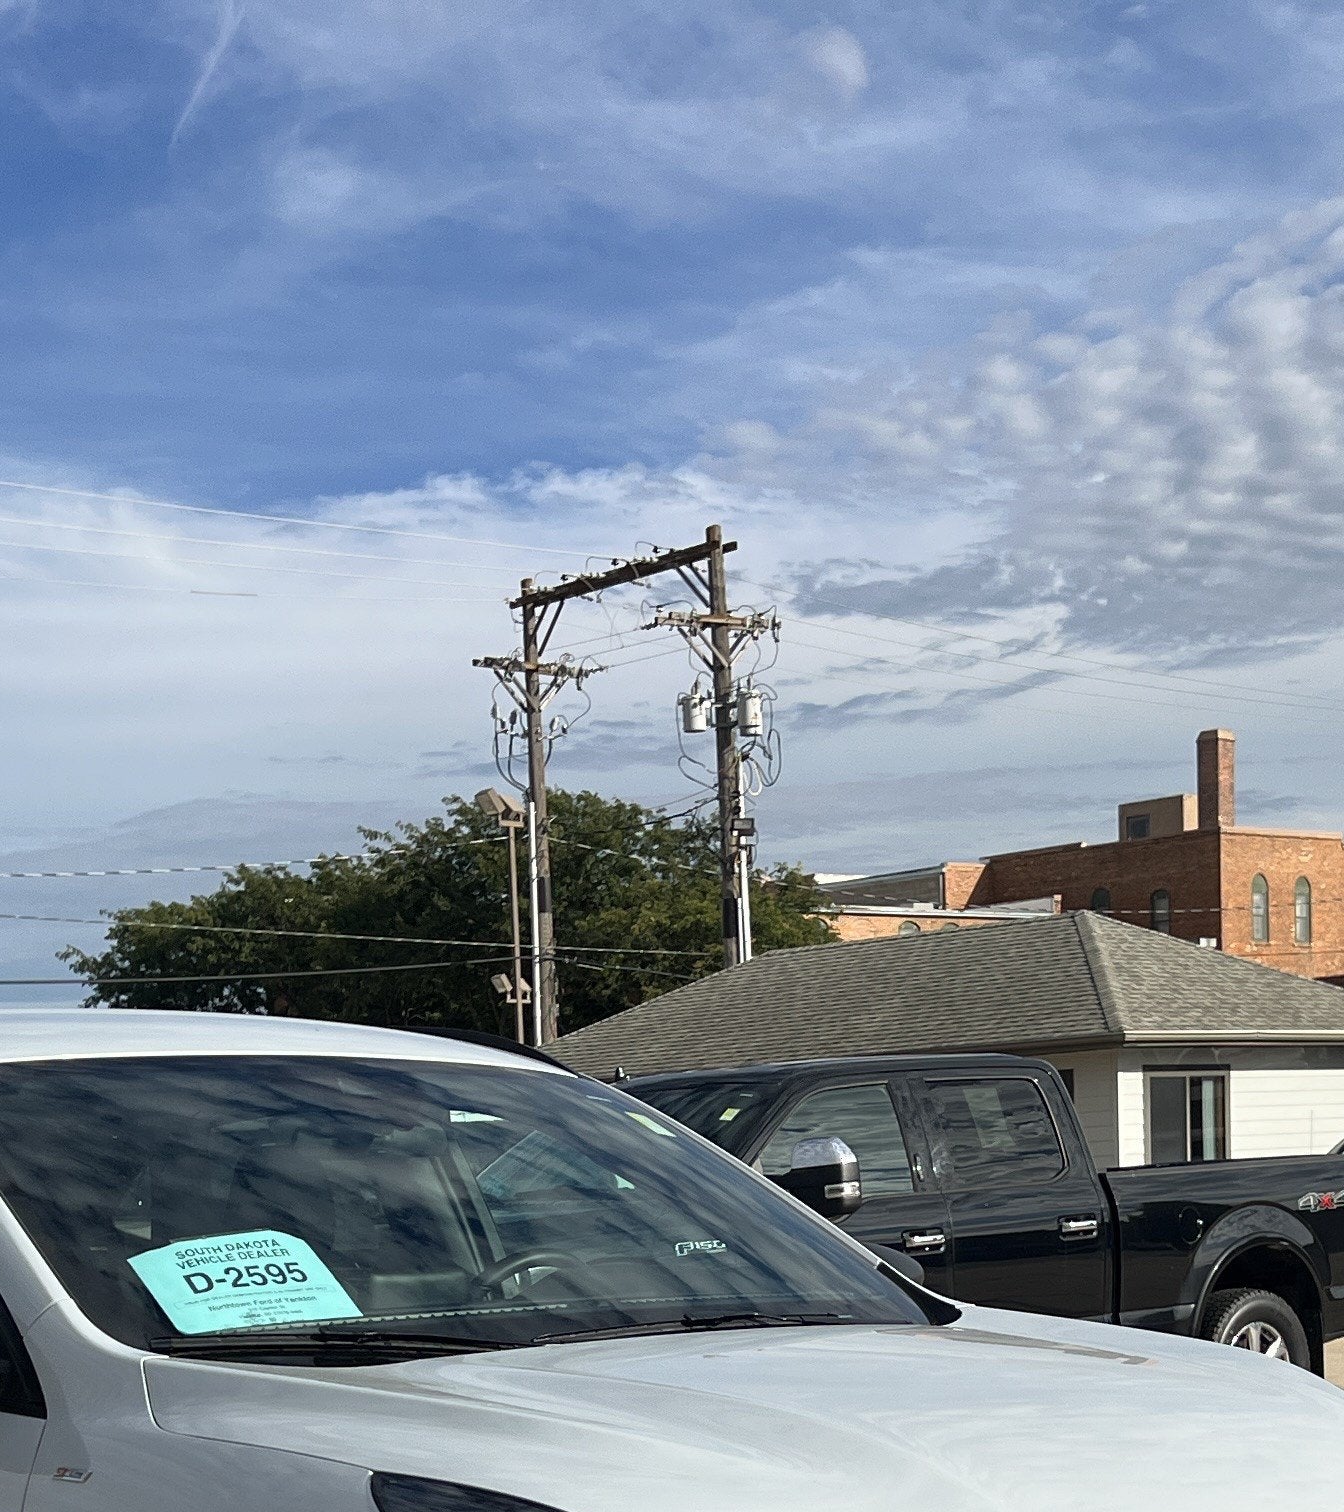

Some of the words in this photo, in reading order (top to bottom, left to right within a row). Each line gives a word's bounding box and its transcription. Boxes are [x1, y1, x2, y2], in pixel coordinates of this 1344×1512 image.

[174, 1245, 222, 1261] SOUTH
[224, 1238, 281, 1252] DAKOTA
[176, 1252, 237, 1270] VEHICLE
[238, 1248, 291, 1261] DEALER
[182, 1261, 308, 1295] D-2595
